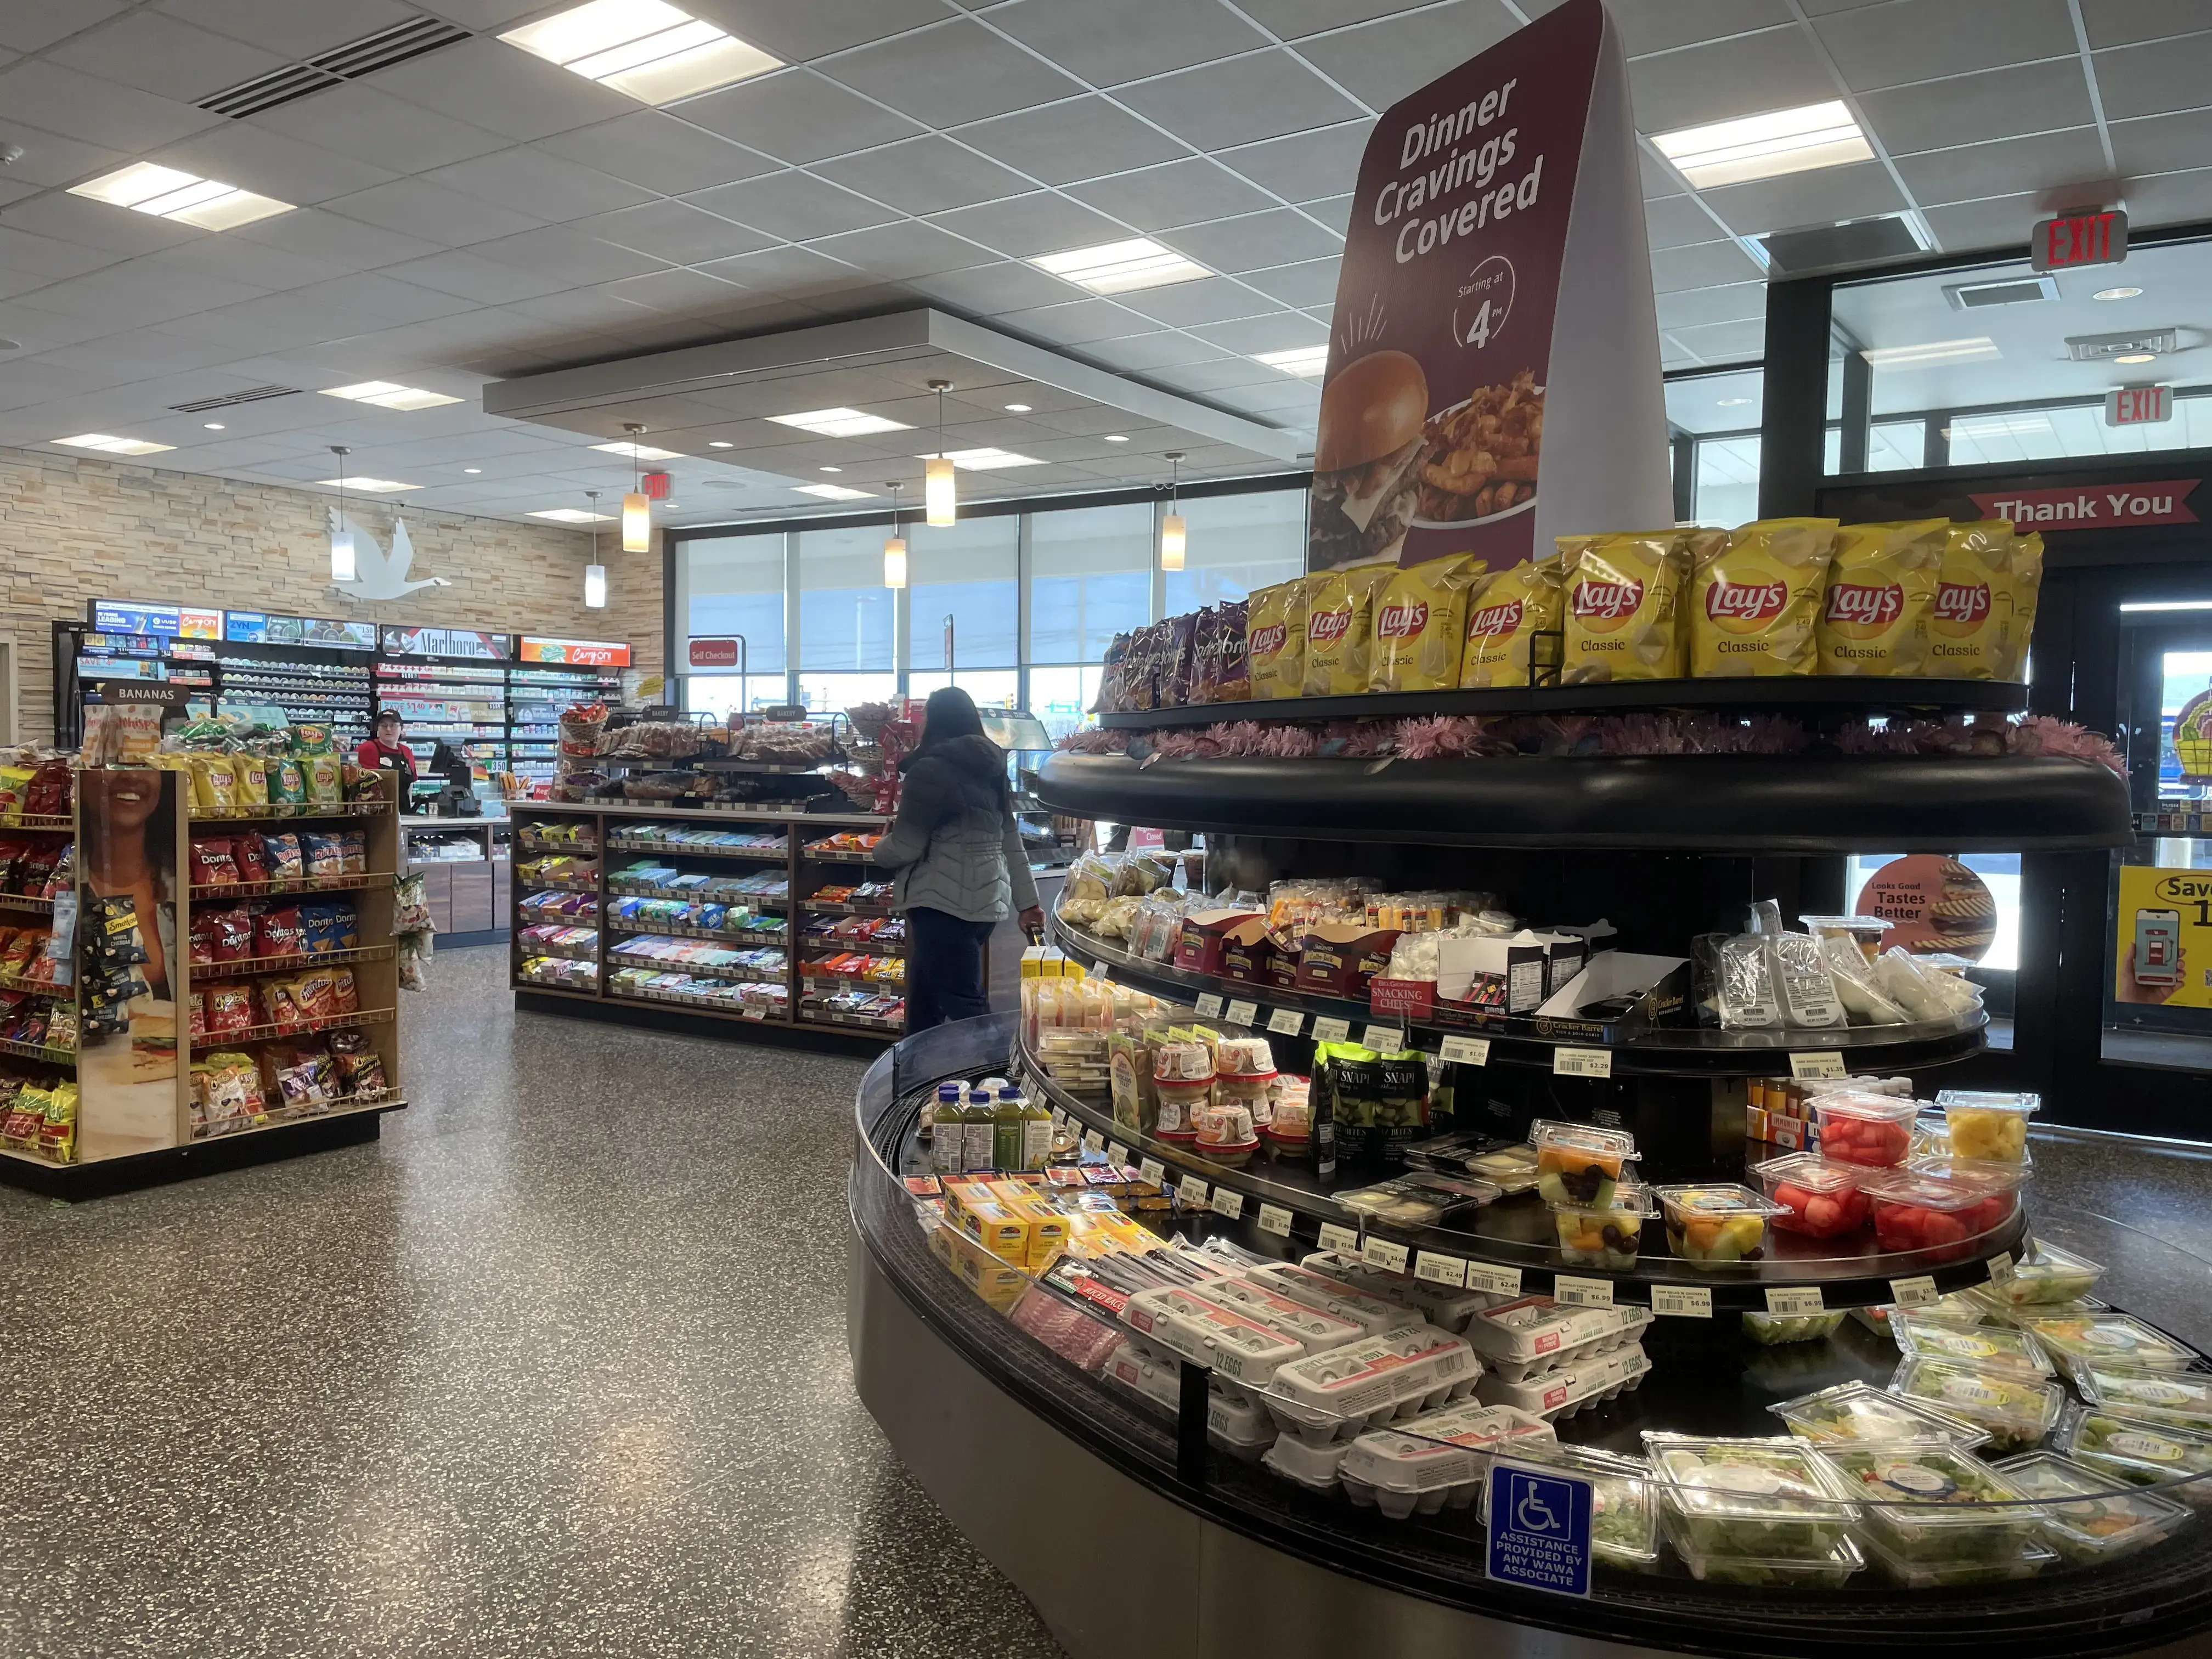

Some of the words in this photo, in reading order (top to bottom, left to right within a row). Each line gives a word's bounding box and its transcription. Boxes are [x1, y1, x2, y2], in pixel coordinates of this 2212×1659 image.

[1400, 77, 1517, 170] Dinner
[1374, 127, 1519, 227] Cravings
[1396, 154, 1545, 264] Covered
[2047, 213, 2115, 266] EXIT
[1458, 274, 1491, 300] Starting
[1493, 271, 1504, 286] at
[1466, 300, 1491, 349] 4
[1492, 307, 1502, 319] PM
[2116, 387, 2165, 422] EXIT
[646, 474, 667, 498] EXIT
[1994, 496, 2097, 523] Thank
[2107, 493, 2172, 516] You
[1577, 580, 1641, 617] Lay's
[1710, 582, 1783, 620] Lay's
[1827, 585, 1899, 624] Lay's
[1310, 611, 1351, 640] Lay's
[1379, 605, 1426, 638] Lay's
[1470, 601, 1520, 636] Lay's
[230, 622, 250, 630] ZYN
[421, 629, 476, 656] Marlboro
[1250, 624, 1284, 654] Lay's
[1581, 639, 1625, 652] Classic
[1718, 640, 1769, 653] Classic
[1835, 646, 1887, 659] Classic
[1932, 644, 1980, 656] Classic
[572, 649, 596, 664] Carry
[1312, 658, 1339, 668] Classic
[1381, 655, 1413, 666] Classic
[1471, 652, 1506, 666] Classic
[1255, 668, 1278, 681] Classic
[119, 689, 174, 700] BANANAS
[119, 717, 156, 730] Whisps
[1877, 891, 1926, 904] Tastes
[1874, 906, 1921, 918] Better
[111, 973, 125, 981] WHITE
[1372, 987, 1423, 1001] SNACKING
[1380, 998, 1414, 1010] CHEESE
[1658, 998, 1671, 1009] Cracker
[1672, 995, 1683, 1005] Barrel
[1553, 1023, 1577, 1031] Cracker
[1578, 1023, 1603, 1032] Barrel
[1340, 1070, 1370, 1085] SNAP!
[1384, 1071, 1415, 1084] SNAP!
[1774, 1116, 1798, 1130] IMMUNITY
[1345, 1127, 1367, 1136] BITES
[1391, 1127, 1413, 1136] BITES
[1391, 1255, 1406, 1263] $4.09
[1446, 1271, 1463, 1279] $2.49
[1083, 1287, 1105, 1300] SLICED
[1104, 1297, 1127, 1310] BACO
[1621, 1310, 1629, 1325] 12
[1628, 1306, 1644, 1323] EGGS
[1383, 1330, 1409, 1342] EGGS
[1409, 1327, 1421, 1335] 12
[1581, 1330, 1593, 1340] LARGE
[1593, 1327, 1604, 1336] EGGS
[1358, 1350, 1384, 1361] EGGS
[1216, 1351, 1224, 1367] 12
[1224, 1356, 1242, 1376] EGGS
[1293, 1359, 1319, 1372] LARGE
[1622, 1361, 1629, 1376] 12
[1629, 1354, 1643, 1373] EGGS
[1585, 1384, 1597, 1393] LARGE
[1597, 1379, 1606, 1387] EGGS
[1459, 1409, 1483, 1421] EGGS
[1484, 1406, 1497, 1415] 12
[1211, 1413, 1229, 1432] EGGS
[1437, 1428, 1464, 1436] EGGS
[1500, 1531, 1578, 1555] ASSISTANCE
[1497, 1541, 1561, 1562] PROVIDED
[1566, 1555, 1582, 1566] BY
[1503, 1553, 1528, 1566] ANY
[1533, 1559, 1574, 1576] WAWA
[1503, 1564, 1573, 1587] ASSOCIATE
